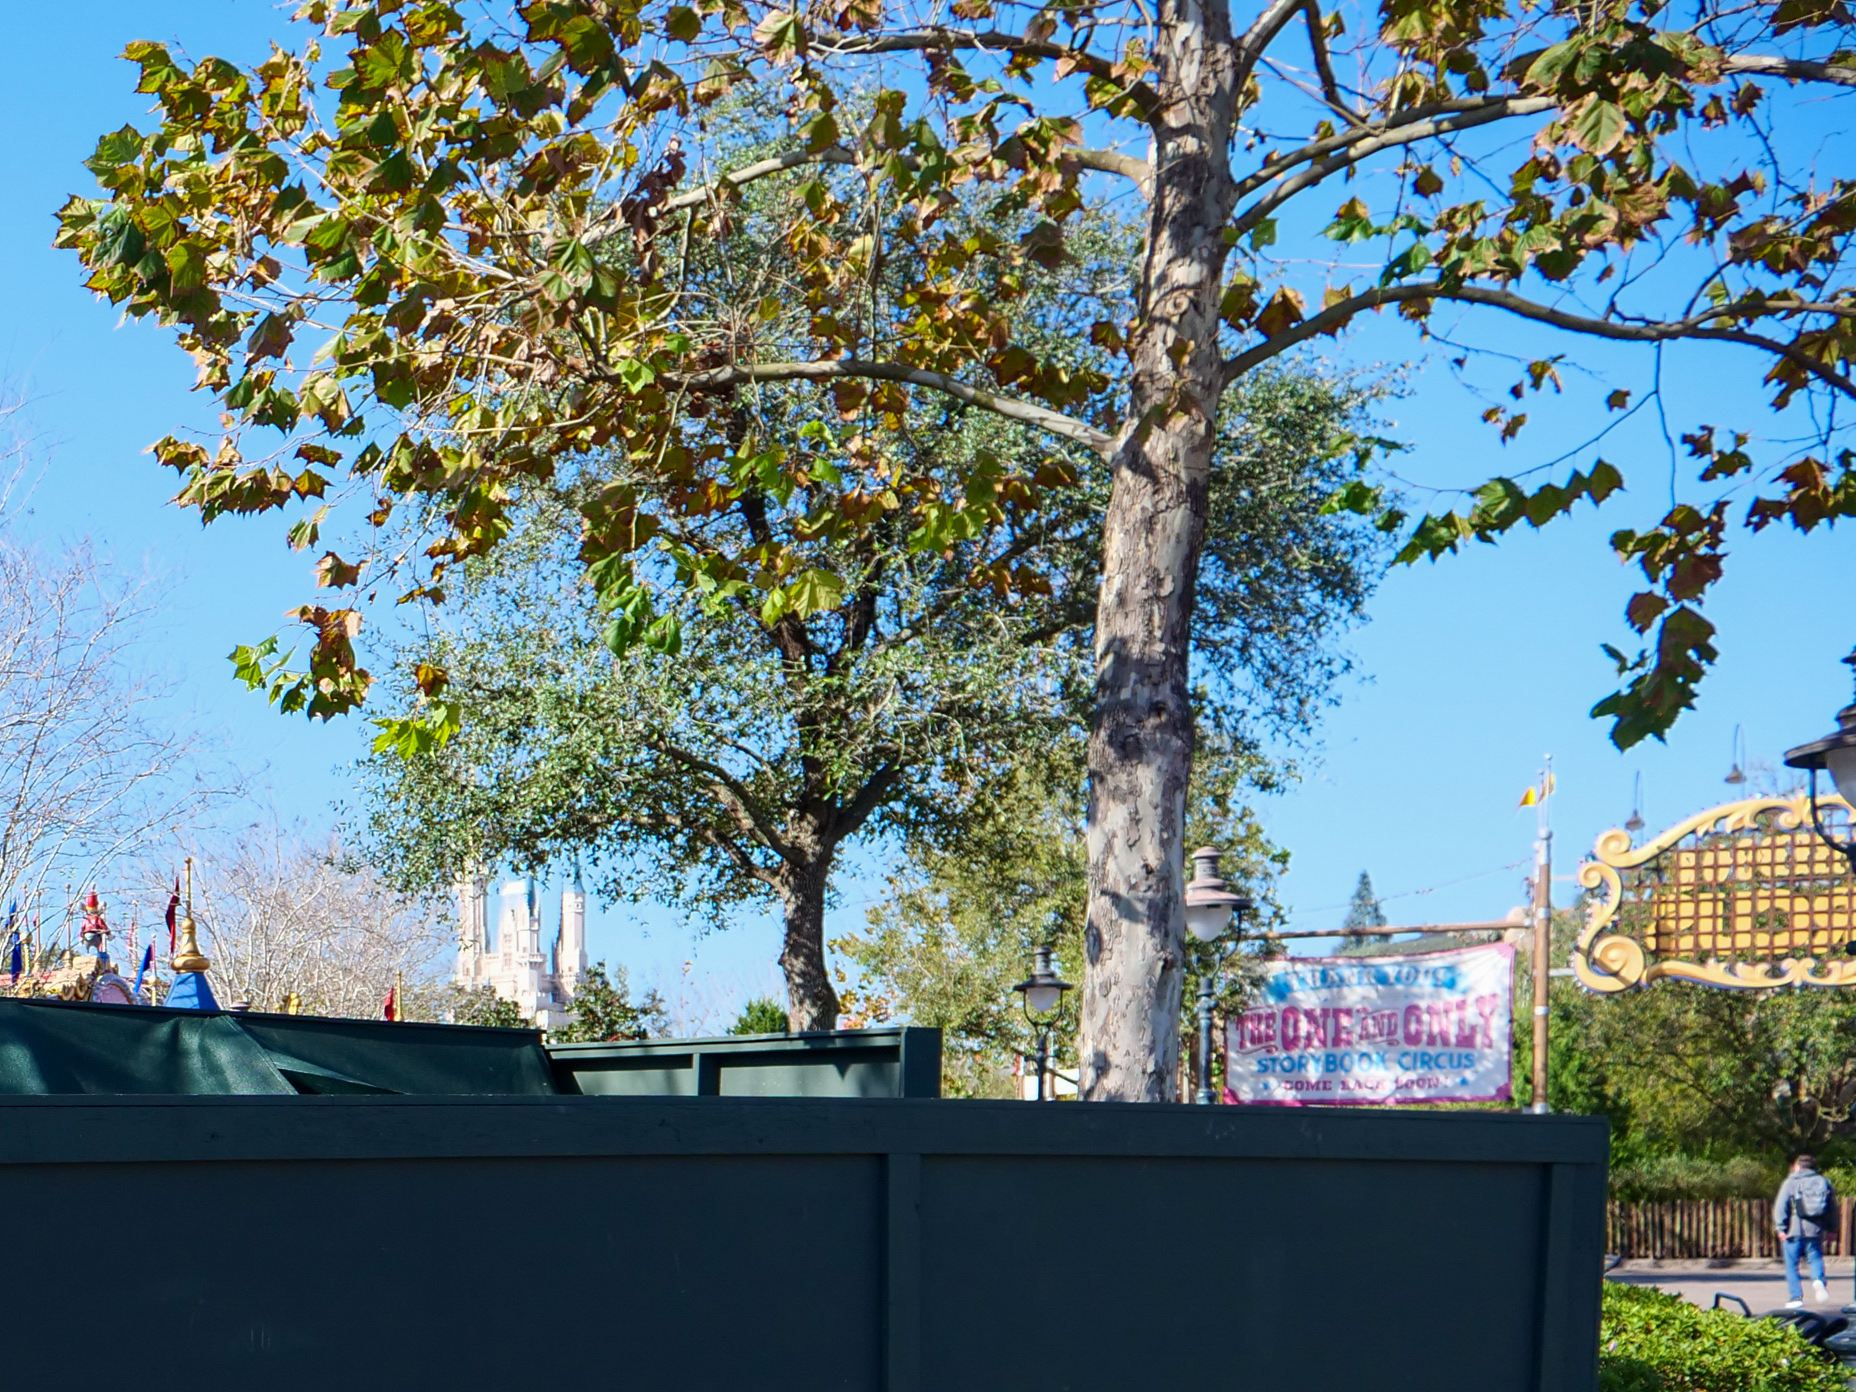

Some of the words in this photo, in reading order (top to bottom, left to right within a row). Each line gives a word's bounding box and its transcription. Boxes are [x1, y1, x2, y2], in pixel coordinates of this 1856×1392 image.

[1286, 966, 1377, 991] THANK
[1235, 1012, 1277, 1050] THE
[1280, 1005, 1354, 1052] ONE
[1358, 1012, 1399, 1042] AND
[1403, 994, 1498, 1050] ONLY
[1256, 1051, 1388, 1074] STORYBOOK
[1397, 1052, 1476, 1071] CIRCUS
[1284, 1080, 1332, 1091] COME
